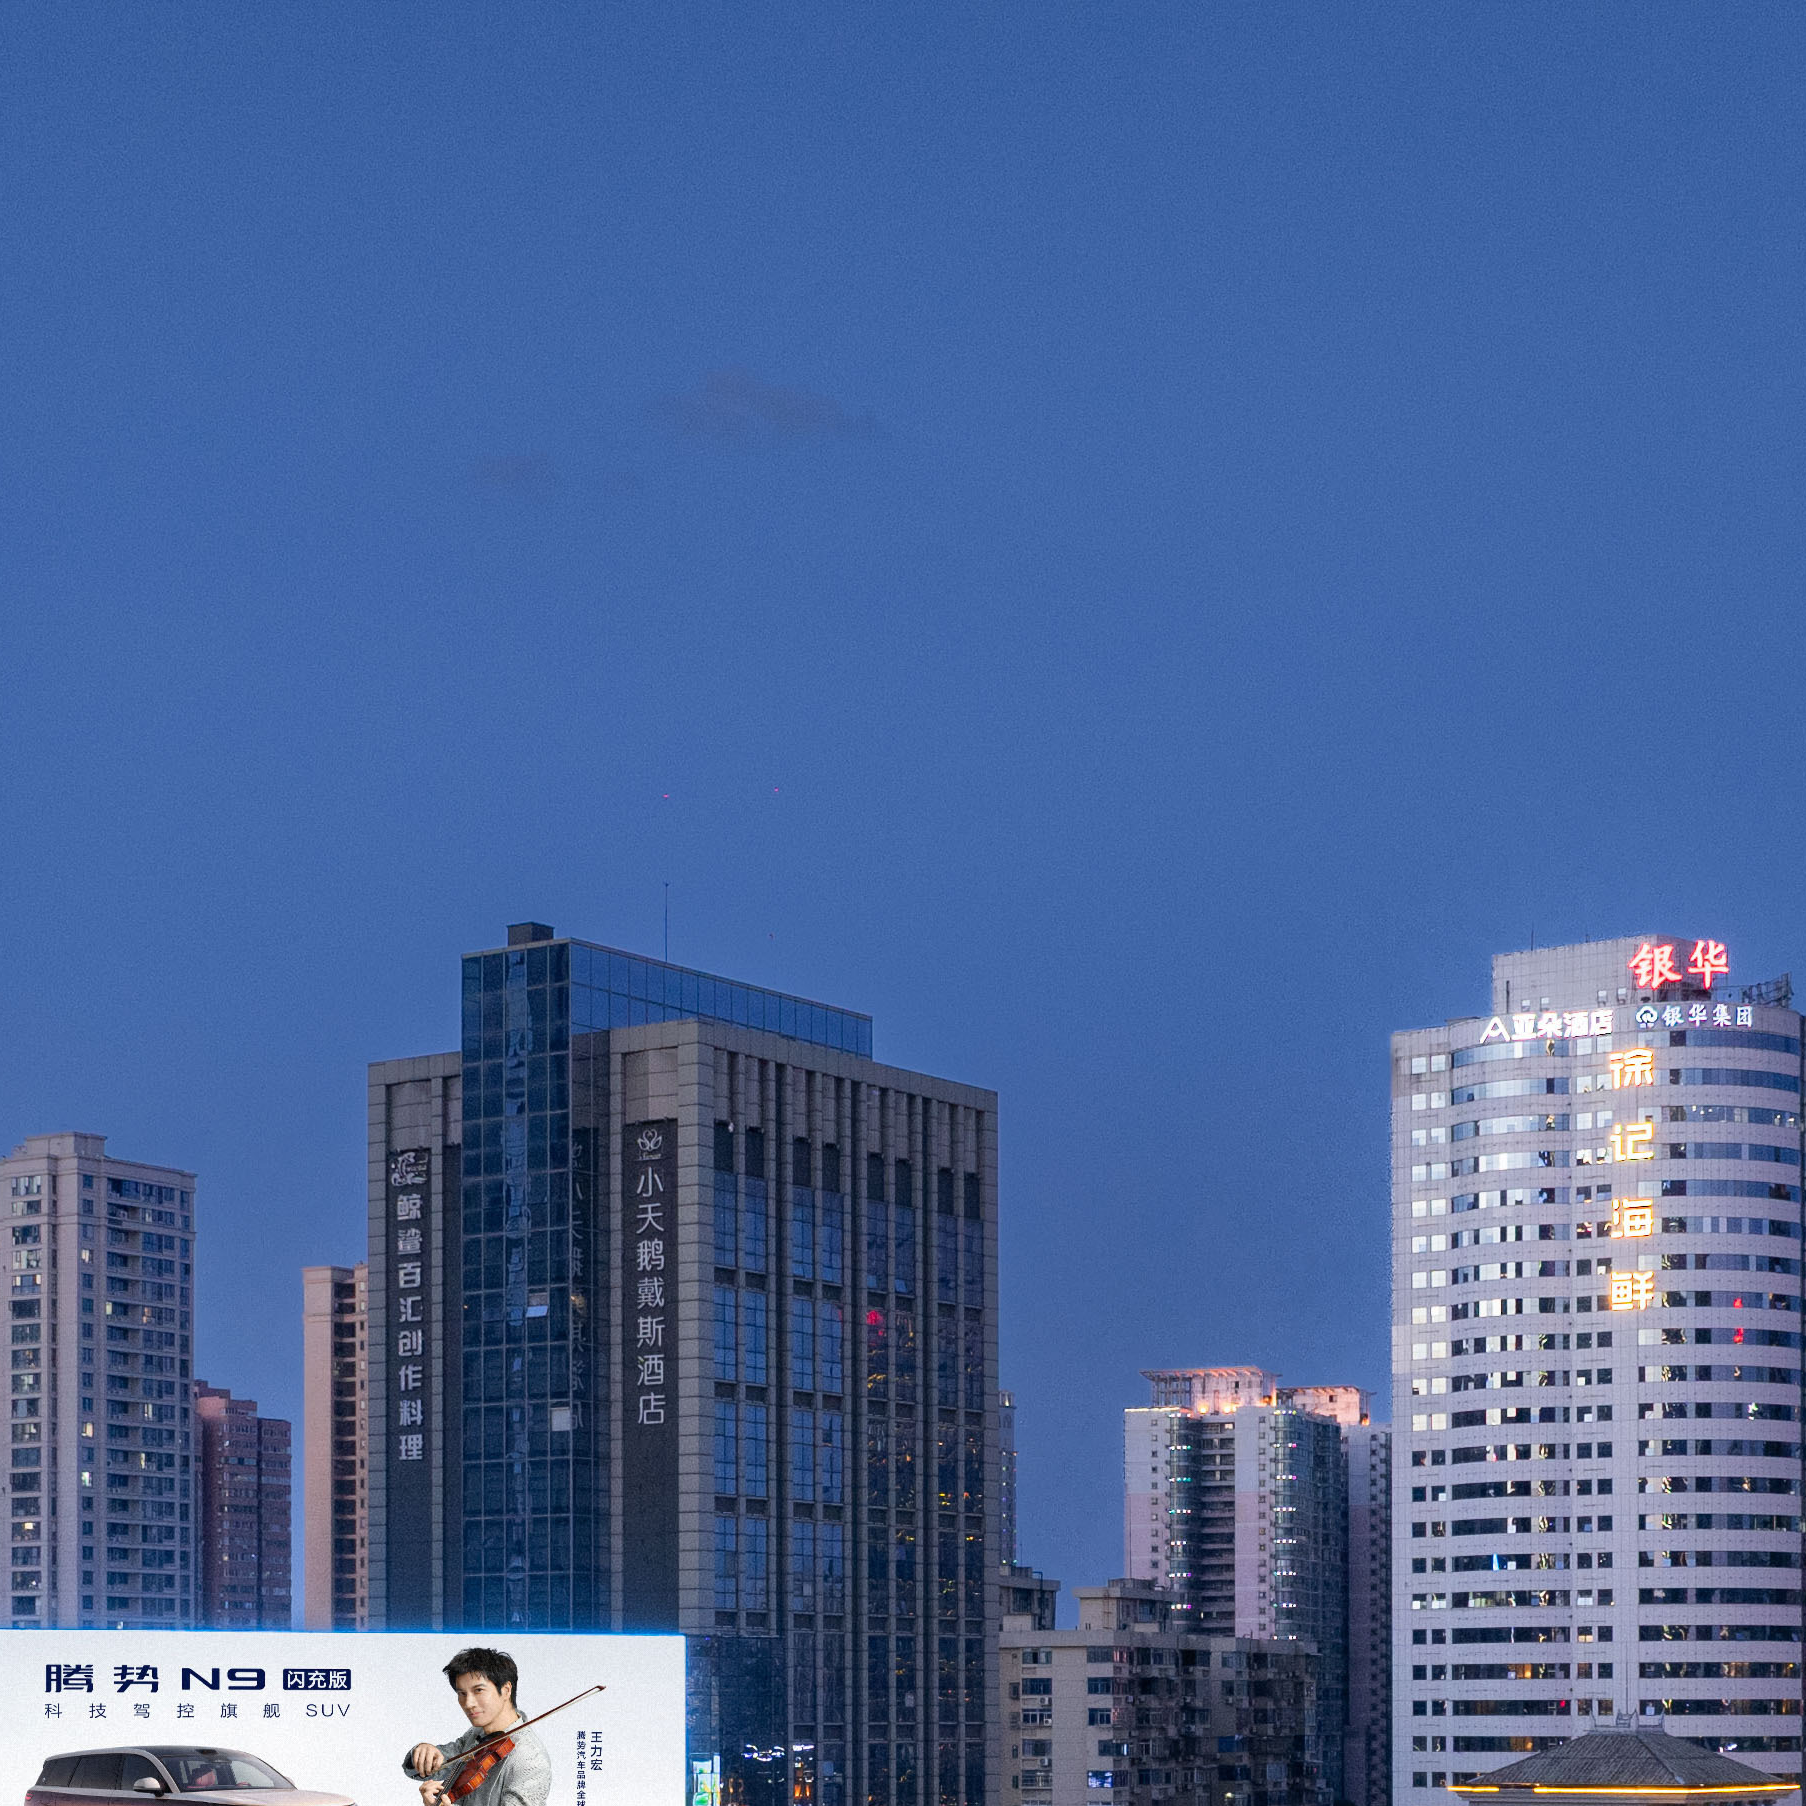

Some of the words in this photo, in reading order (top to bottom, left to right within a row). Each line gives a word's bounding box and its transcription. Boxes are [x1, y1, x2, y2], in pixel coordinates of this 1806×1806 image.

[1628, 940, 1729, 990] 银华
[1511, 1009, 1614, 1041] 亚朵酒店
[1662, 1005, 1755, 1028] 银华集团
[1609, 1048, 1655, 1311] 徐记海鲜
[636, 1167, 666, 1424] 小天鹅戴斯酒店
[396, 1194, 423, 1461] 鲸鲨百汇创作料理
[45, 1664, 159, 1693] 腾势
[182, 1667, 266, 1692] N9
[287, 1669, 348, 1691] 闪充版
[44, 1703, 281, 1720] 科技驾控旗舰
[306, 1704, 351, 1718] SUV
[590, 1732, 603, 1771] 王力宏
